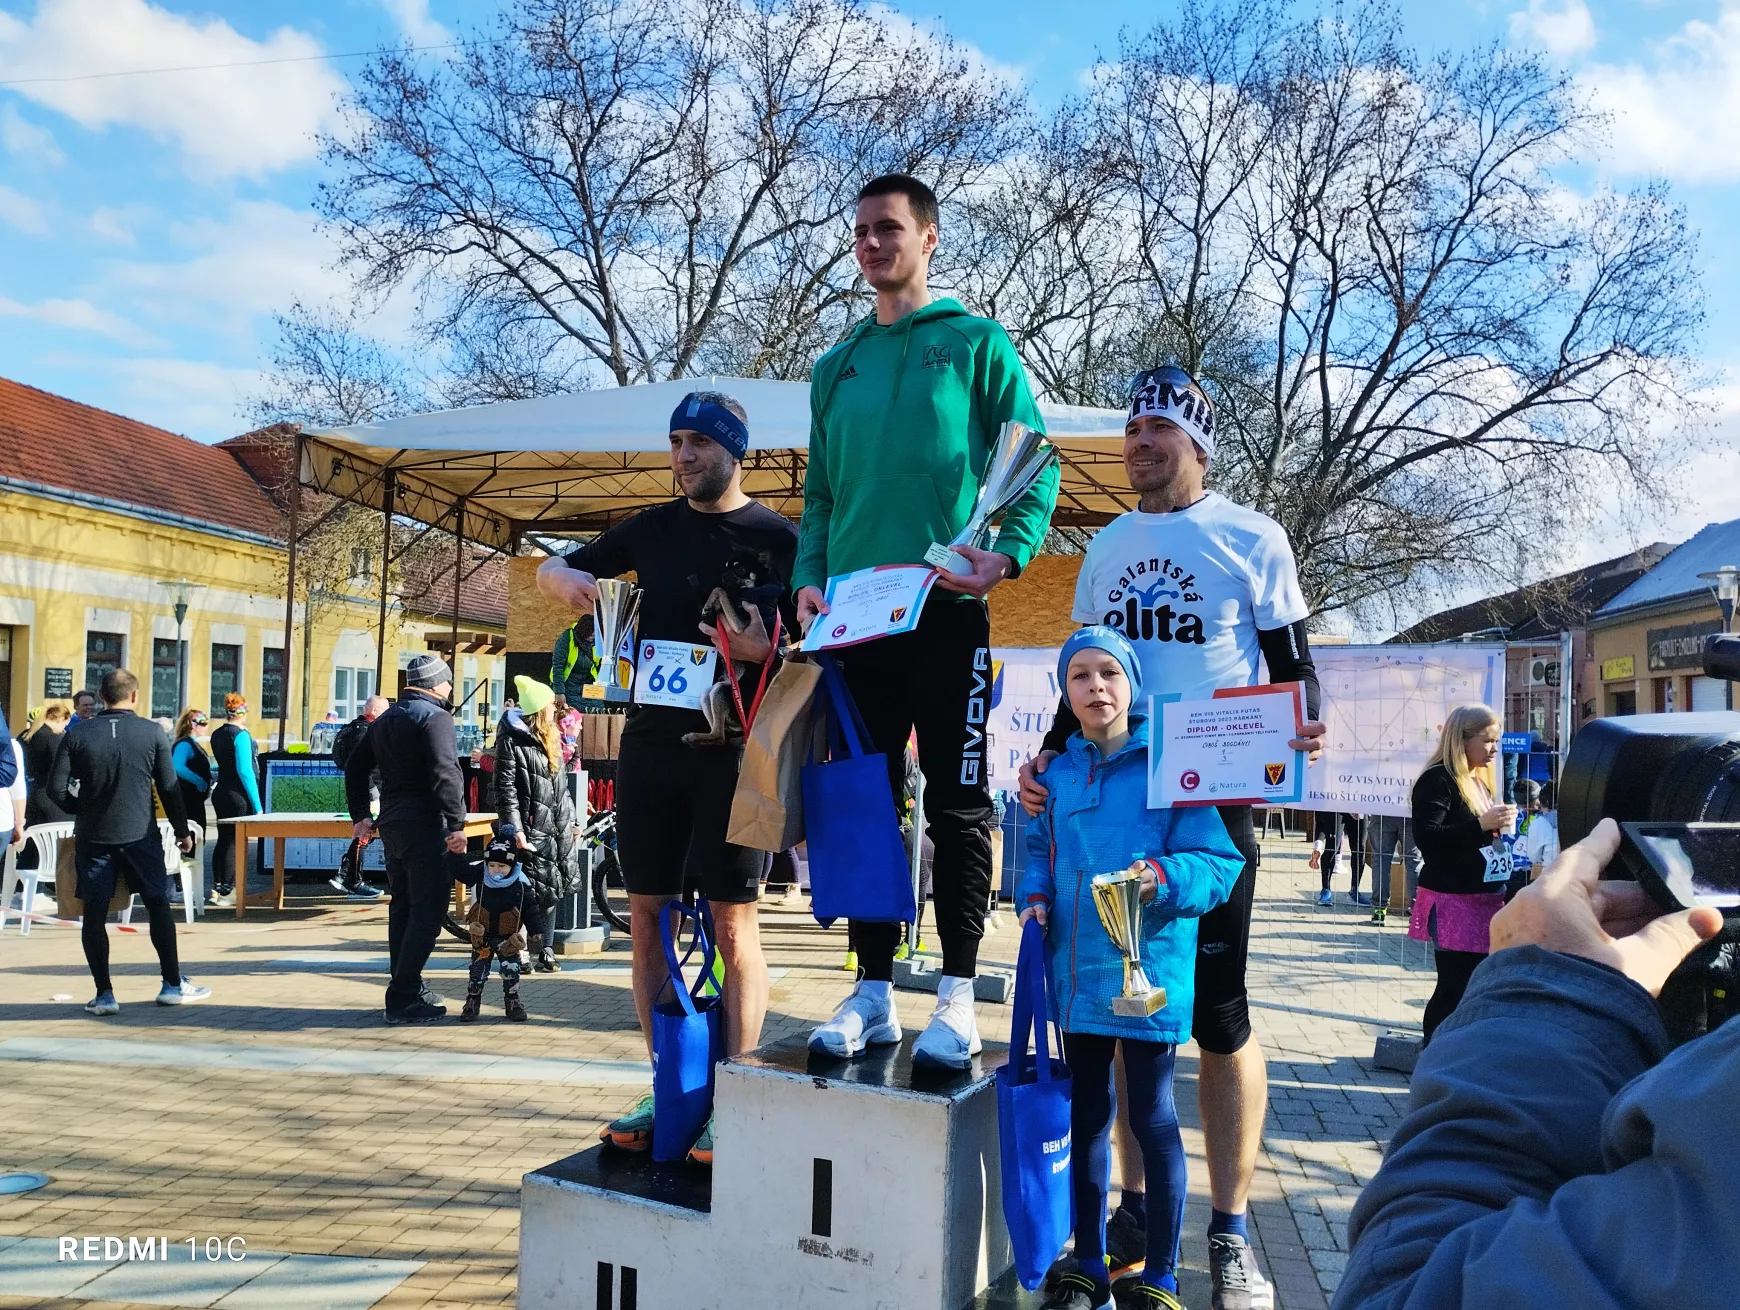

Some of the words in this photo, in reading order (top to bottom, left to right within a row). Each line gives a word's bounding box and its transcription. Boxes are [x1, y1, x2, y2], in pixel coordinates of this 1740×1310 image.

[1108, 558, 1204, 602] Galantská
[1103, 597, 1206, 645] elita
[648, 665, 688, 694] 66
[960, 647, 988, 785] GIVOVA
[1010, 706, 1055, 733] ŠTÚ
[1187, 725, 1218, 734] DIPLOM
[1339, 775, 1353, 783] OZ
[1356, 775, 1373, 784] VIS
[1308, 791, 1337, 800] IESTO
[1490, 856, 1512, 875] 236
[1042, 1140, 1061, 1154] BEH
